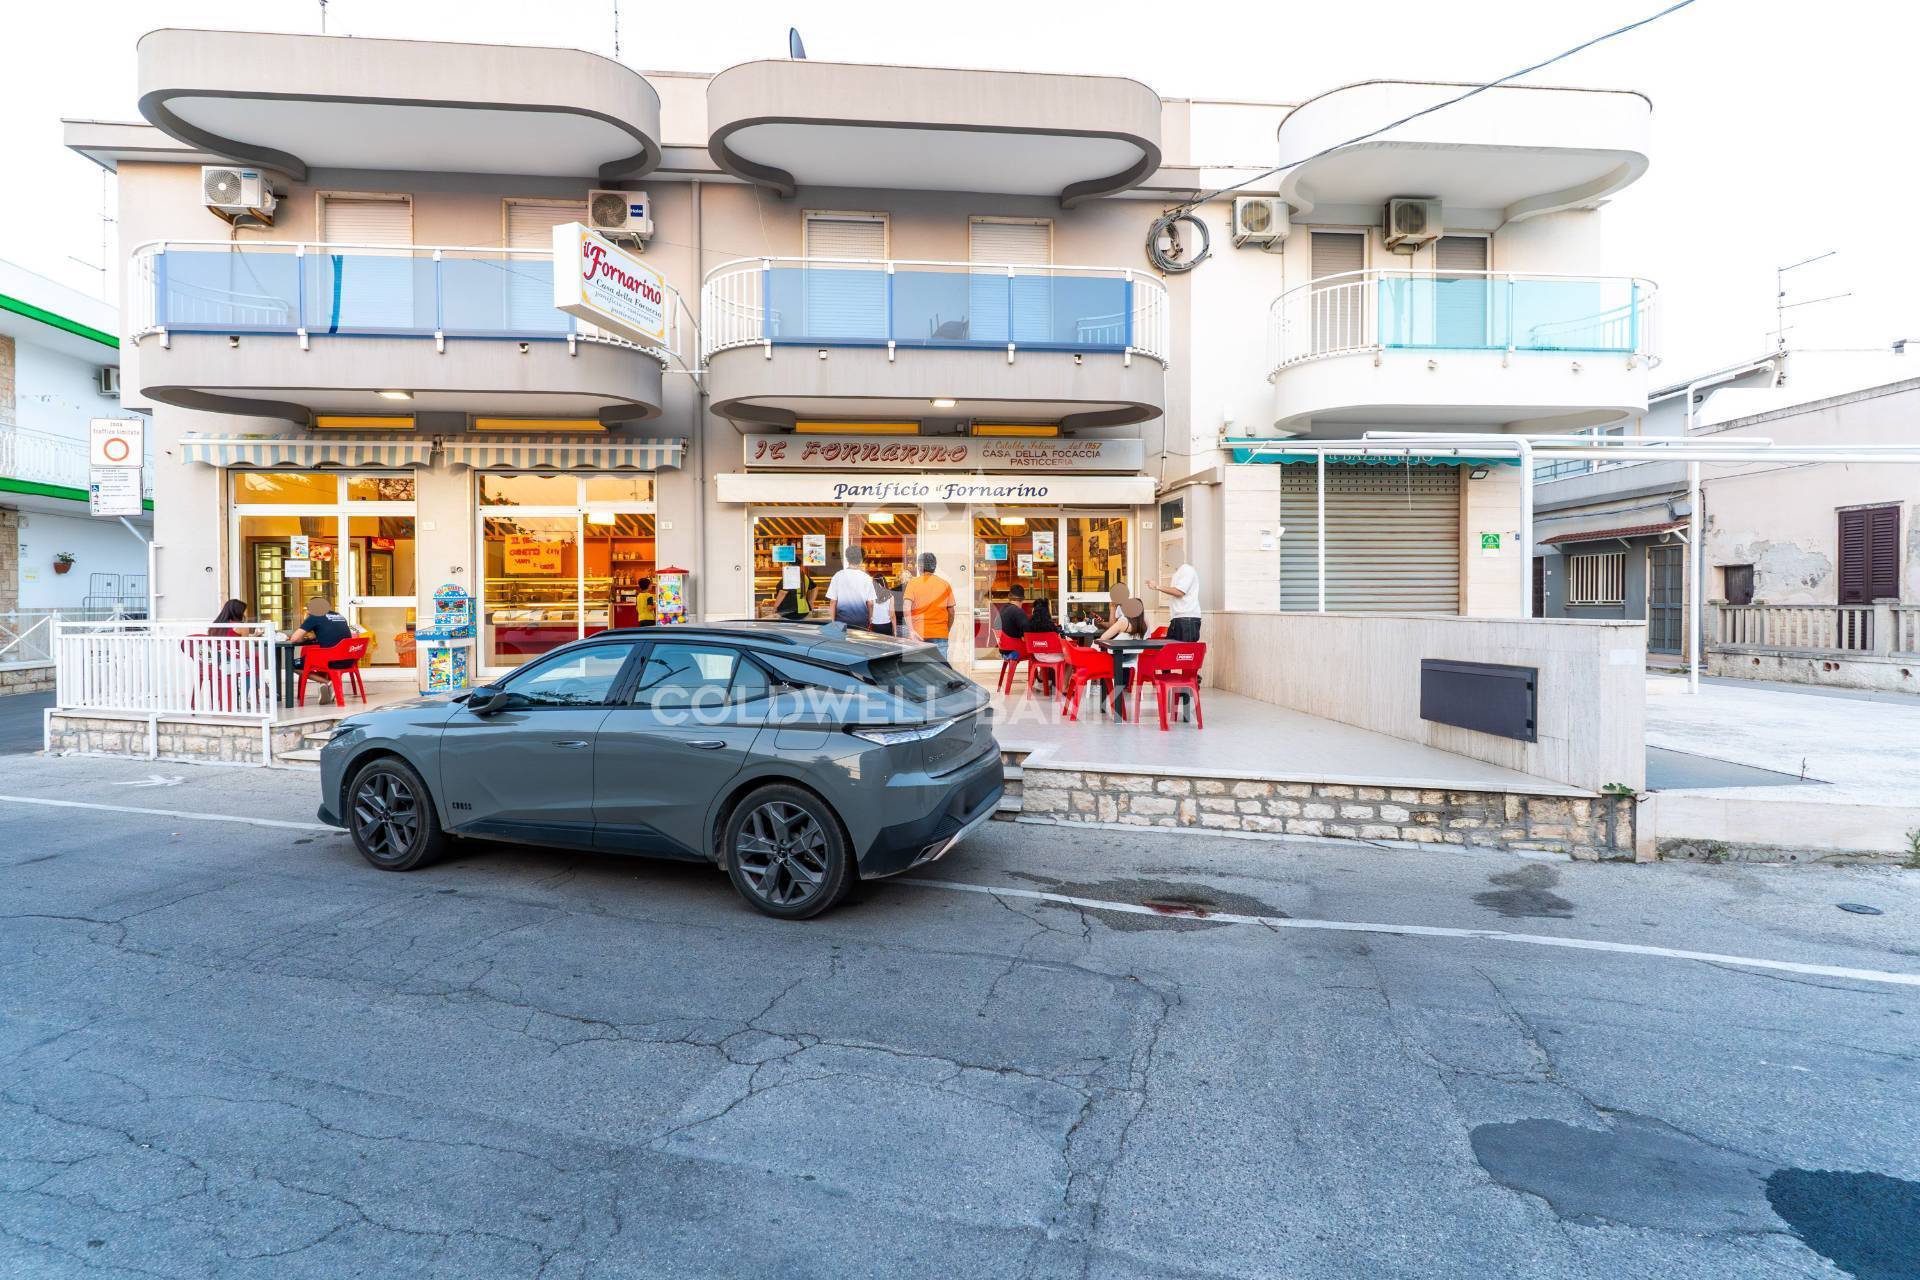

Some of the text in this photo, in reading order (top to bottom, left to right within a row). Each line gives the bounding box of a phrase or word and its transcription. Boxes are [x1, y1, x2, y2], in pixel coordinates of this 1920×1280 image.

[583, 245, 661, 304] Fornarino
[801, 441, 968, 464] FORNARINO
[982, 450, 1101, 458] CASA DELLA FOCACCIA
[1010, 458, 1073, 466] PASTICCERIA
[833, 481, 929, 499] Panificio
[942, 482, 1049, 500] Fornarino
